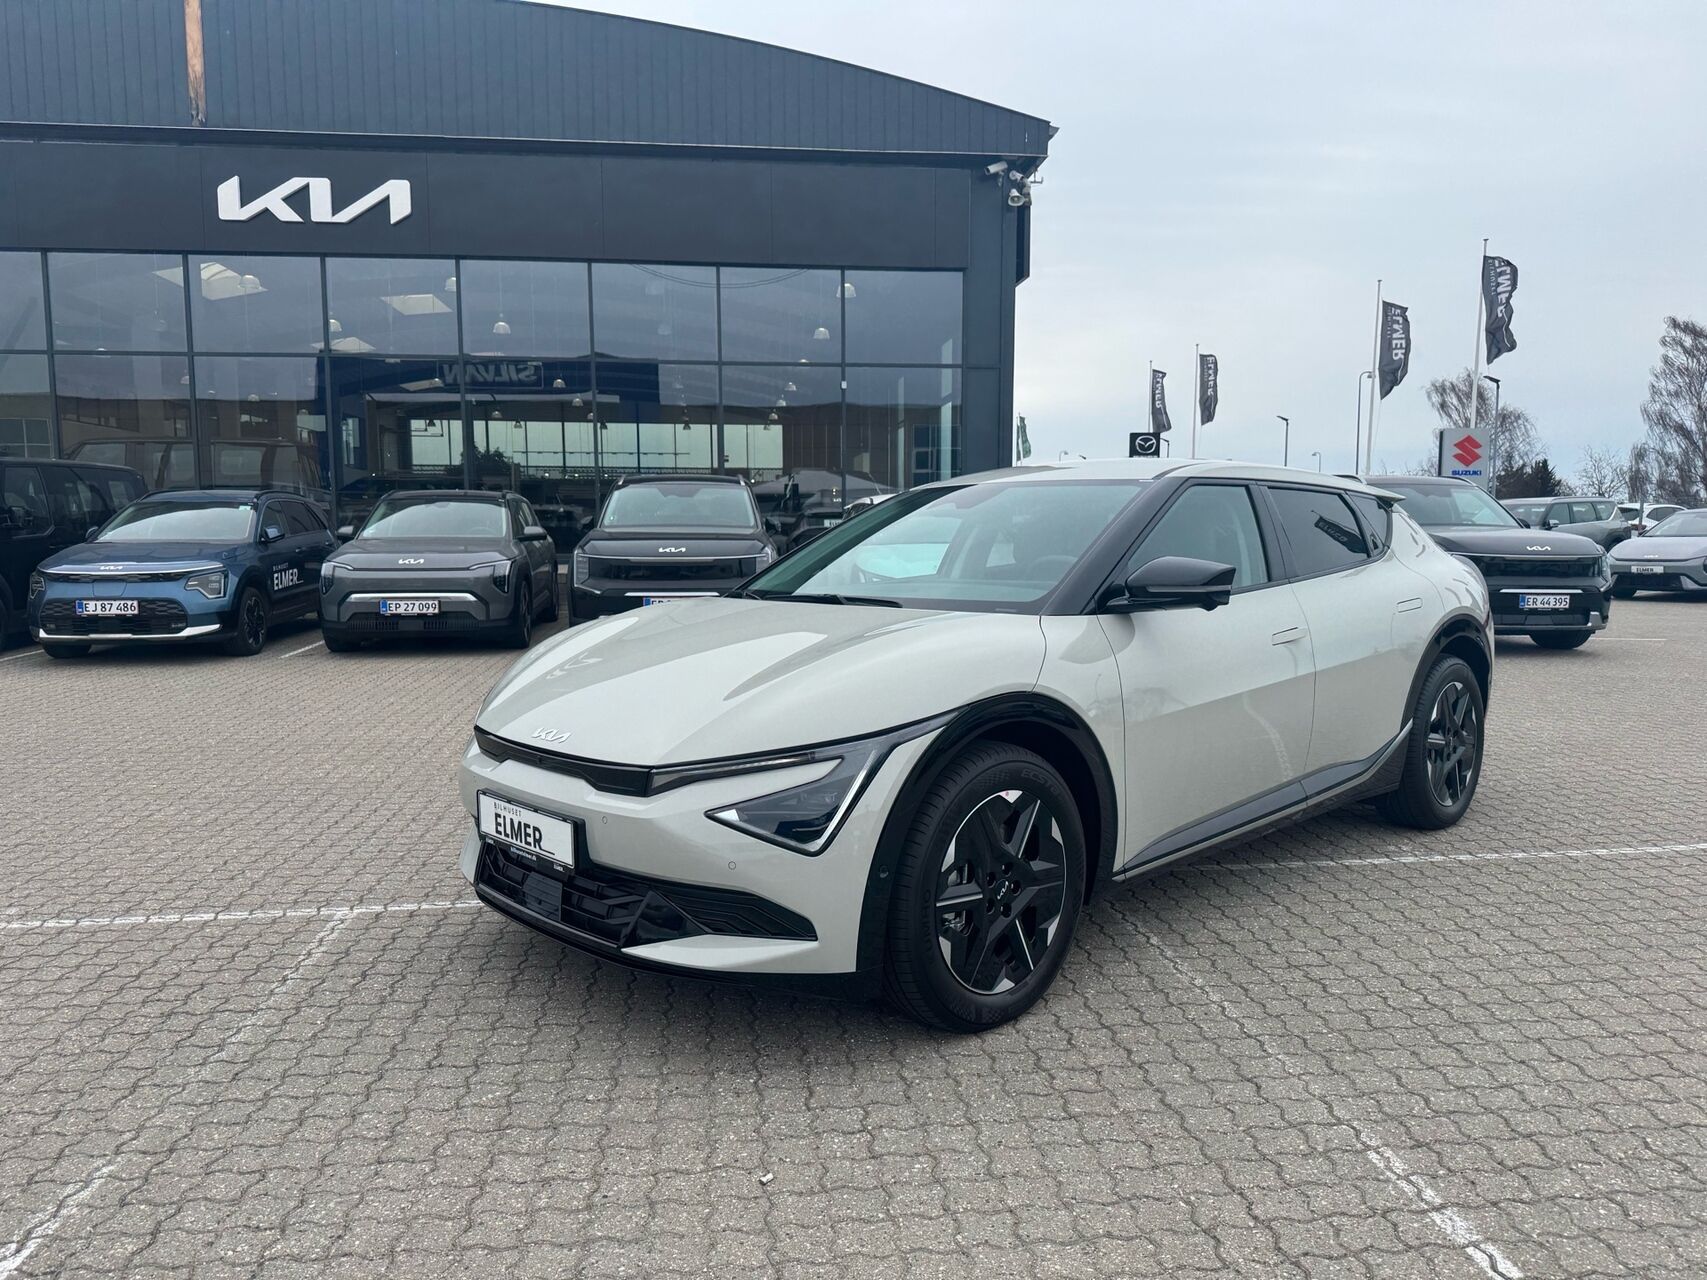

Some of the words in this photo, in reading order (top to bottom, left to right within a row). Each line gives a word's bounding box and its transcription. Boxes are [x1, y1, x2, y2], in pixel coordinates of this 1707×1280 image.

[217, 175, 412, 225] KIA
[273, 568, 304, 591] ELMER
[84, 602, 98, 613] EJ
[100, 602, 113, 613] 87
[116, 602, 136, 613] 486
[388, 602, 401, 612] EP
[403, 602, 416, 612] 27
[418, 602, 437, 612] 099
[1526, 597, 1538, 607] ER
[1539, 597, 1551, 607] 44
[1552, 597, 1568, 607] 395
[493, 801, 522, 817] BILHUSET
[494, 812, 555, 856] ELMER
